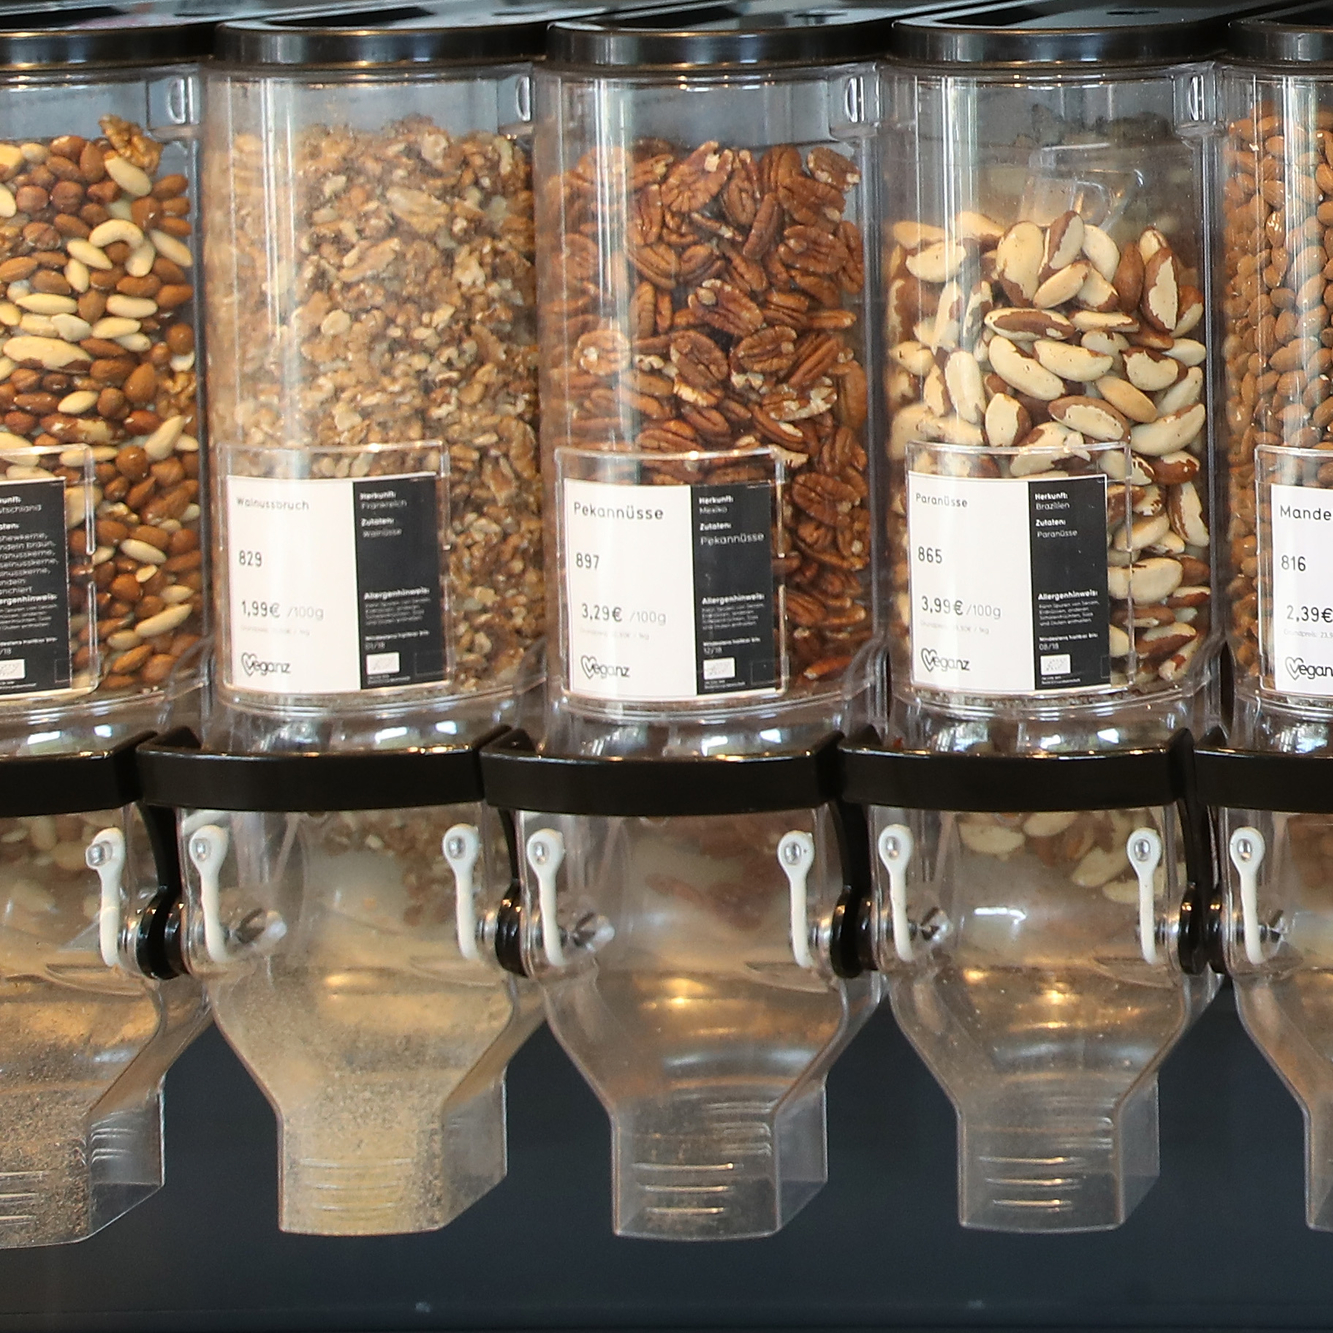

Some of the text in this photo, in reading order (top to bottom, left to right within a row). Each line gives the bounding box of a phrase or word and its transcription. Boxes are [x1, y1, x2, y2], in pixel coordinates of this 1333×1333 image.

[915, 493, 968, 508] Paranüsse
[573, 501, 664, 520] Pekannüsse
[700, 532, 764, 546] Pekannüsse
[239, 550, 262, 567] 829
[576, 553, 599, 570] 897
[918, 547, 943, 564] 865
[1281, 555, 1306, 571] 816
[241, 601, 280, 618] 1,99€
[581, 604, 623, 622] 3,29€
[921, 596, 963, 616] 3,99€
[1286, 605, 1333, 623] 2,39€
